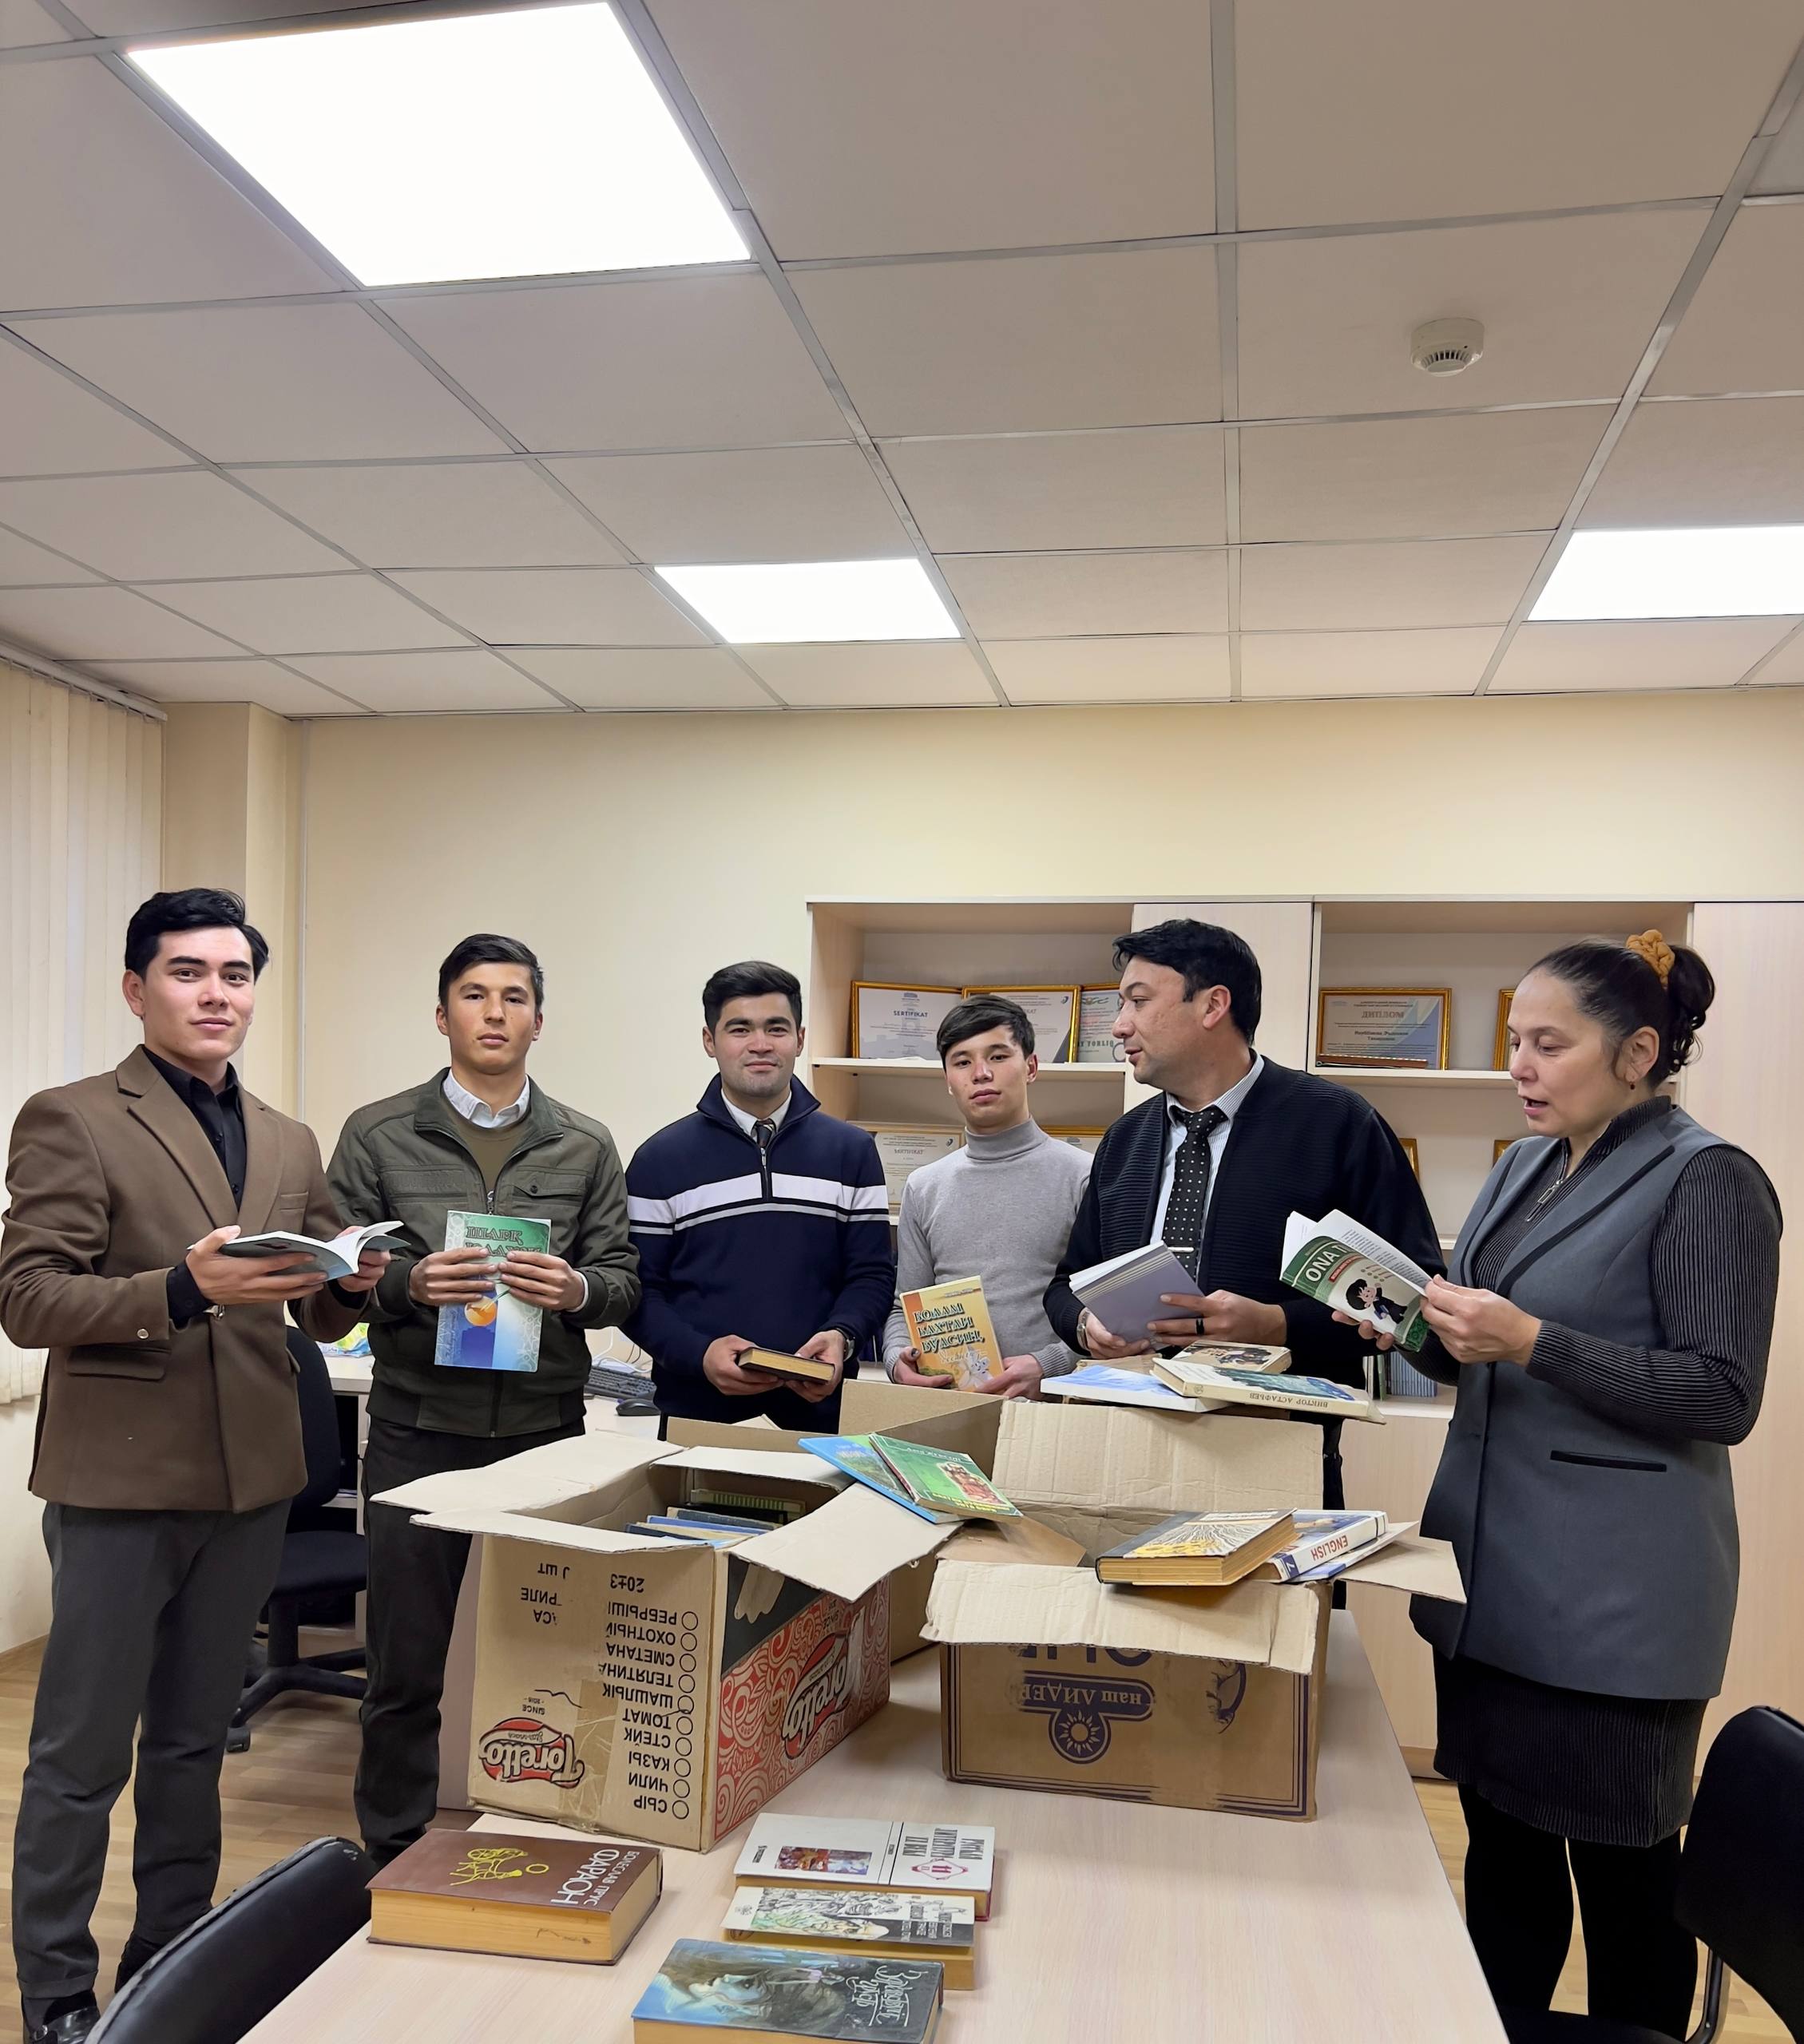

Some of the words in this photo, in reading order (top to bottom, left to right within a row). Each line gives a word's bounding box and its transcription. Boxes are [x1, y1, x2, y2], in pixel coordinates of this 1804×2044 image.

[1361, 1010, 1405, 1020] ДИПЛОМ
[1305, 1250, 1341, 1282] ONA
[913, 1302, 965, 1324] БОЛАМ
[1249, 1392, 1294, 1404] АСТАФЬЕВ
[1296, 1399, 1329, 1408] ВИКТОР
[1310, 1535, 1349, 1562] ENGLISH
[610, 1573, 645, 1593] 20±3
[521, 1587, 562, 1606] РИЛЕ
[608, 1601, 677, 1626] РЕБРЫШ
[605, 1622, 676, 1646] ОХОТНЫЙ
[606, 1642, 675, 1666] СМЕТАНА
[602, 1683, 673, 1709] ШАШЛЫК
[1022, 1682, 1097, 1705] ЛИДЕР
[1101, 1689, 1142, 1705] наш
[521, 1704, 545, 1716] SINCE
[622, 1708, 672, 1729] ТОМАТ
[624, 1727, 671, 1749] СТЕЙК
[628, 1750, 670, 1772] КАЗЫ
[628, 1772, 668, 1792] ЧИЛИ
[633, 1794, 668, 1813] СЫР
[550, 1848, 620, 1905] ФАРАОН
[601, 1851, 640, 1884] БОЛЕСЛАВ
[931, 1864, 953, 1873] 11
[583, 1884, 610, 1906] ПРУС
